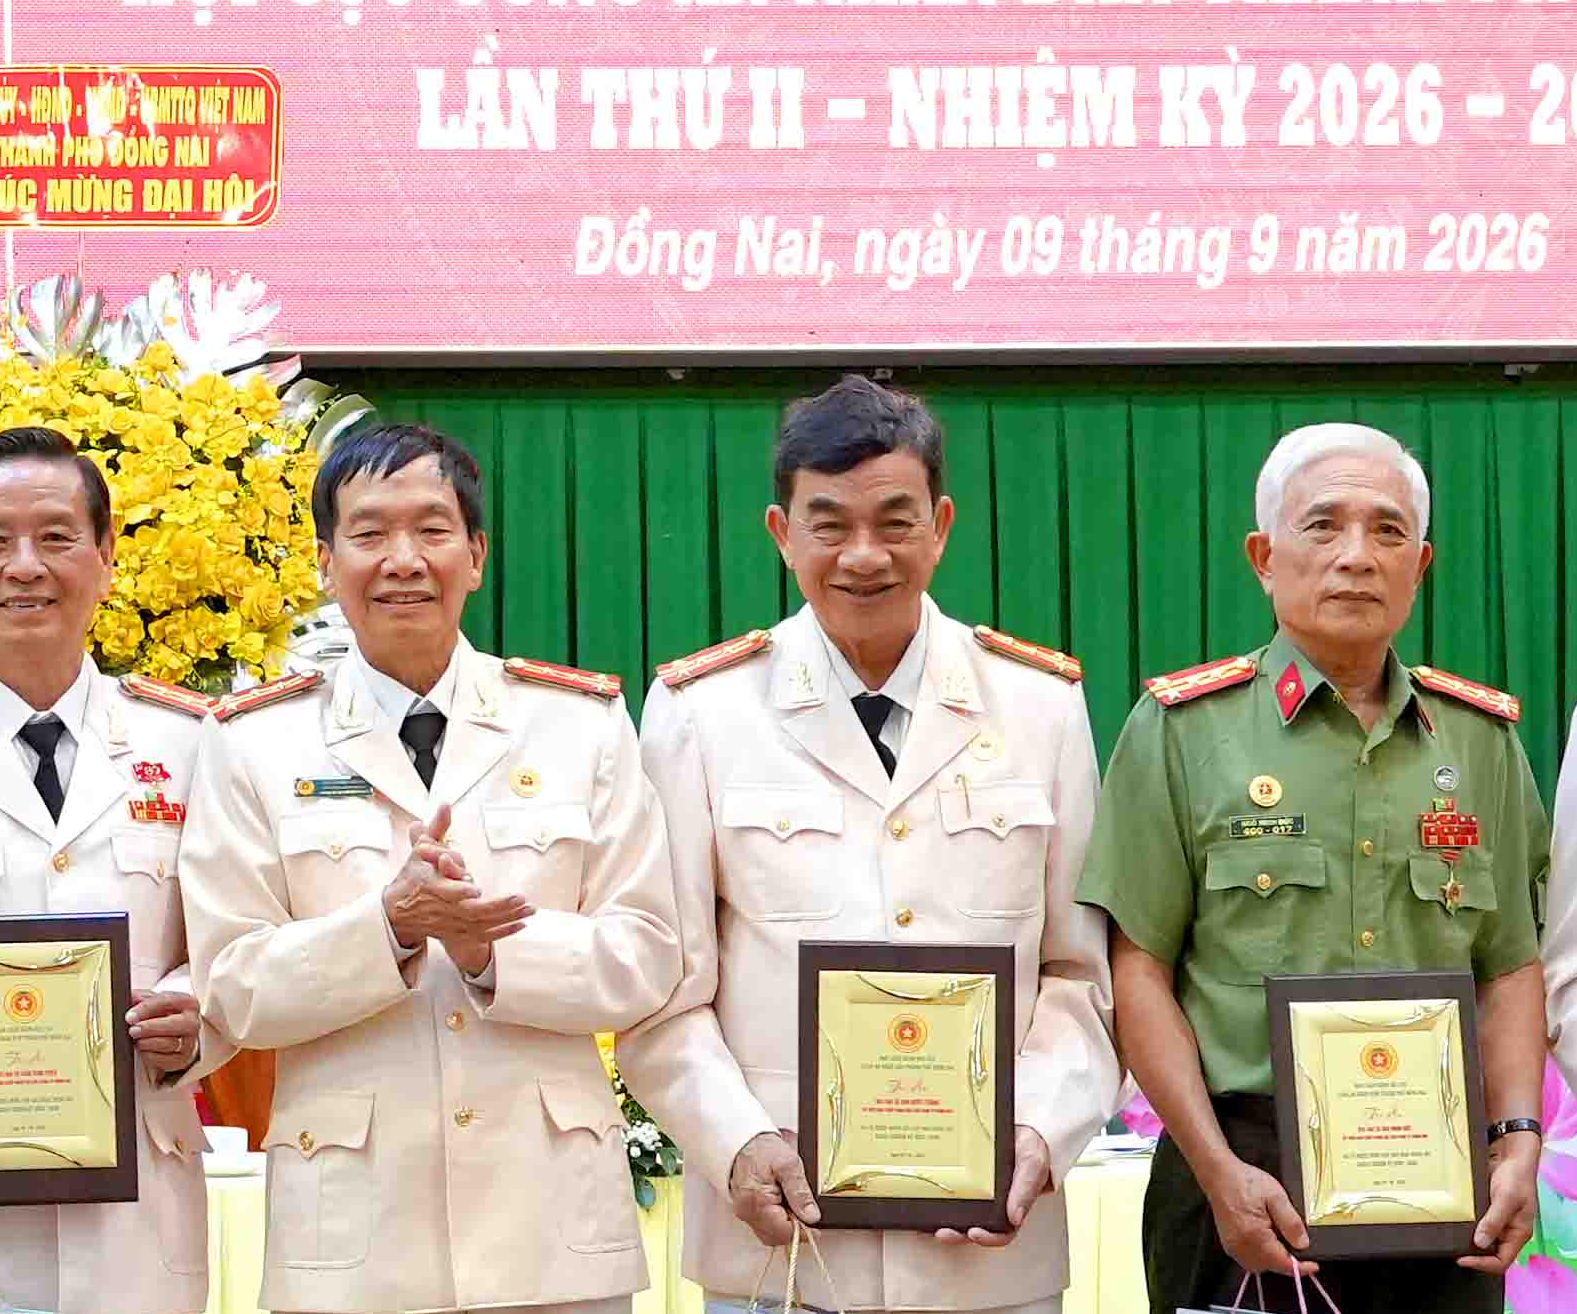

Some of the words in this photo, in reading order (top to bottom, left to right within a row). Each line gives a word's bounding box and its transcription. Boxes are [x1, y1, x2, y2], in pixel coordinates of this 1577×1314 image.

[233, 86, 266, 125] NAM
[415, 34, 558, 151] LẦN
[581, 48, 737, 151] THỨ
[747, 67, 805, 151] II
[887, 45, 1138, 169] NHIỆM
[1157, 46, 1257, 149] KỲ
[1278, 61, 1444, 147] 2026
[174, 136, 210, 167] NAI
[45, 173, 133, 214] MỪNG
[142, 179, 193, 219] ĐẠI
[574, 207, 718, 291] Đồng
[735, 216, 834, 286] Nai,
[854, 211, 986, 292] ngày
[1000, 214, 1063, 277] 09
[1079, 210, 1232, 290] tháng
[1248, 215, 1280, 276] 9
[1295, 211, 1405, 274] năm
[1423, 212, 1551, 274] 2026
